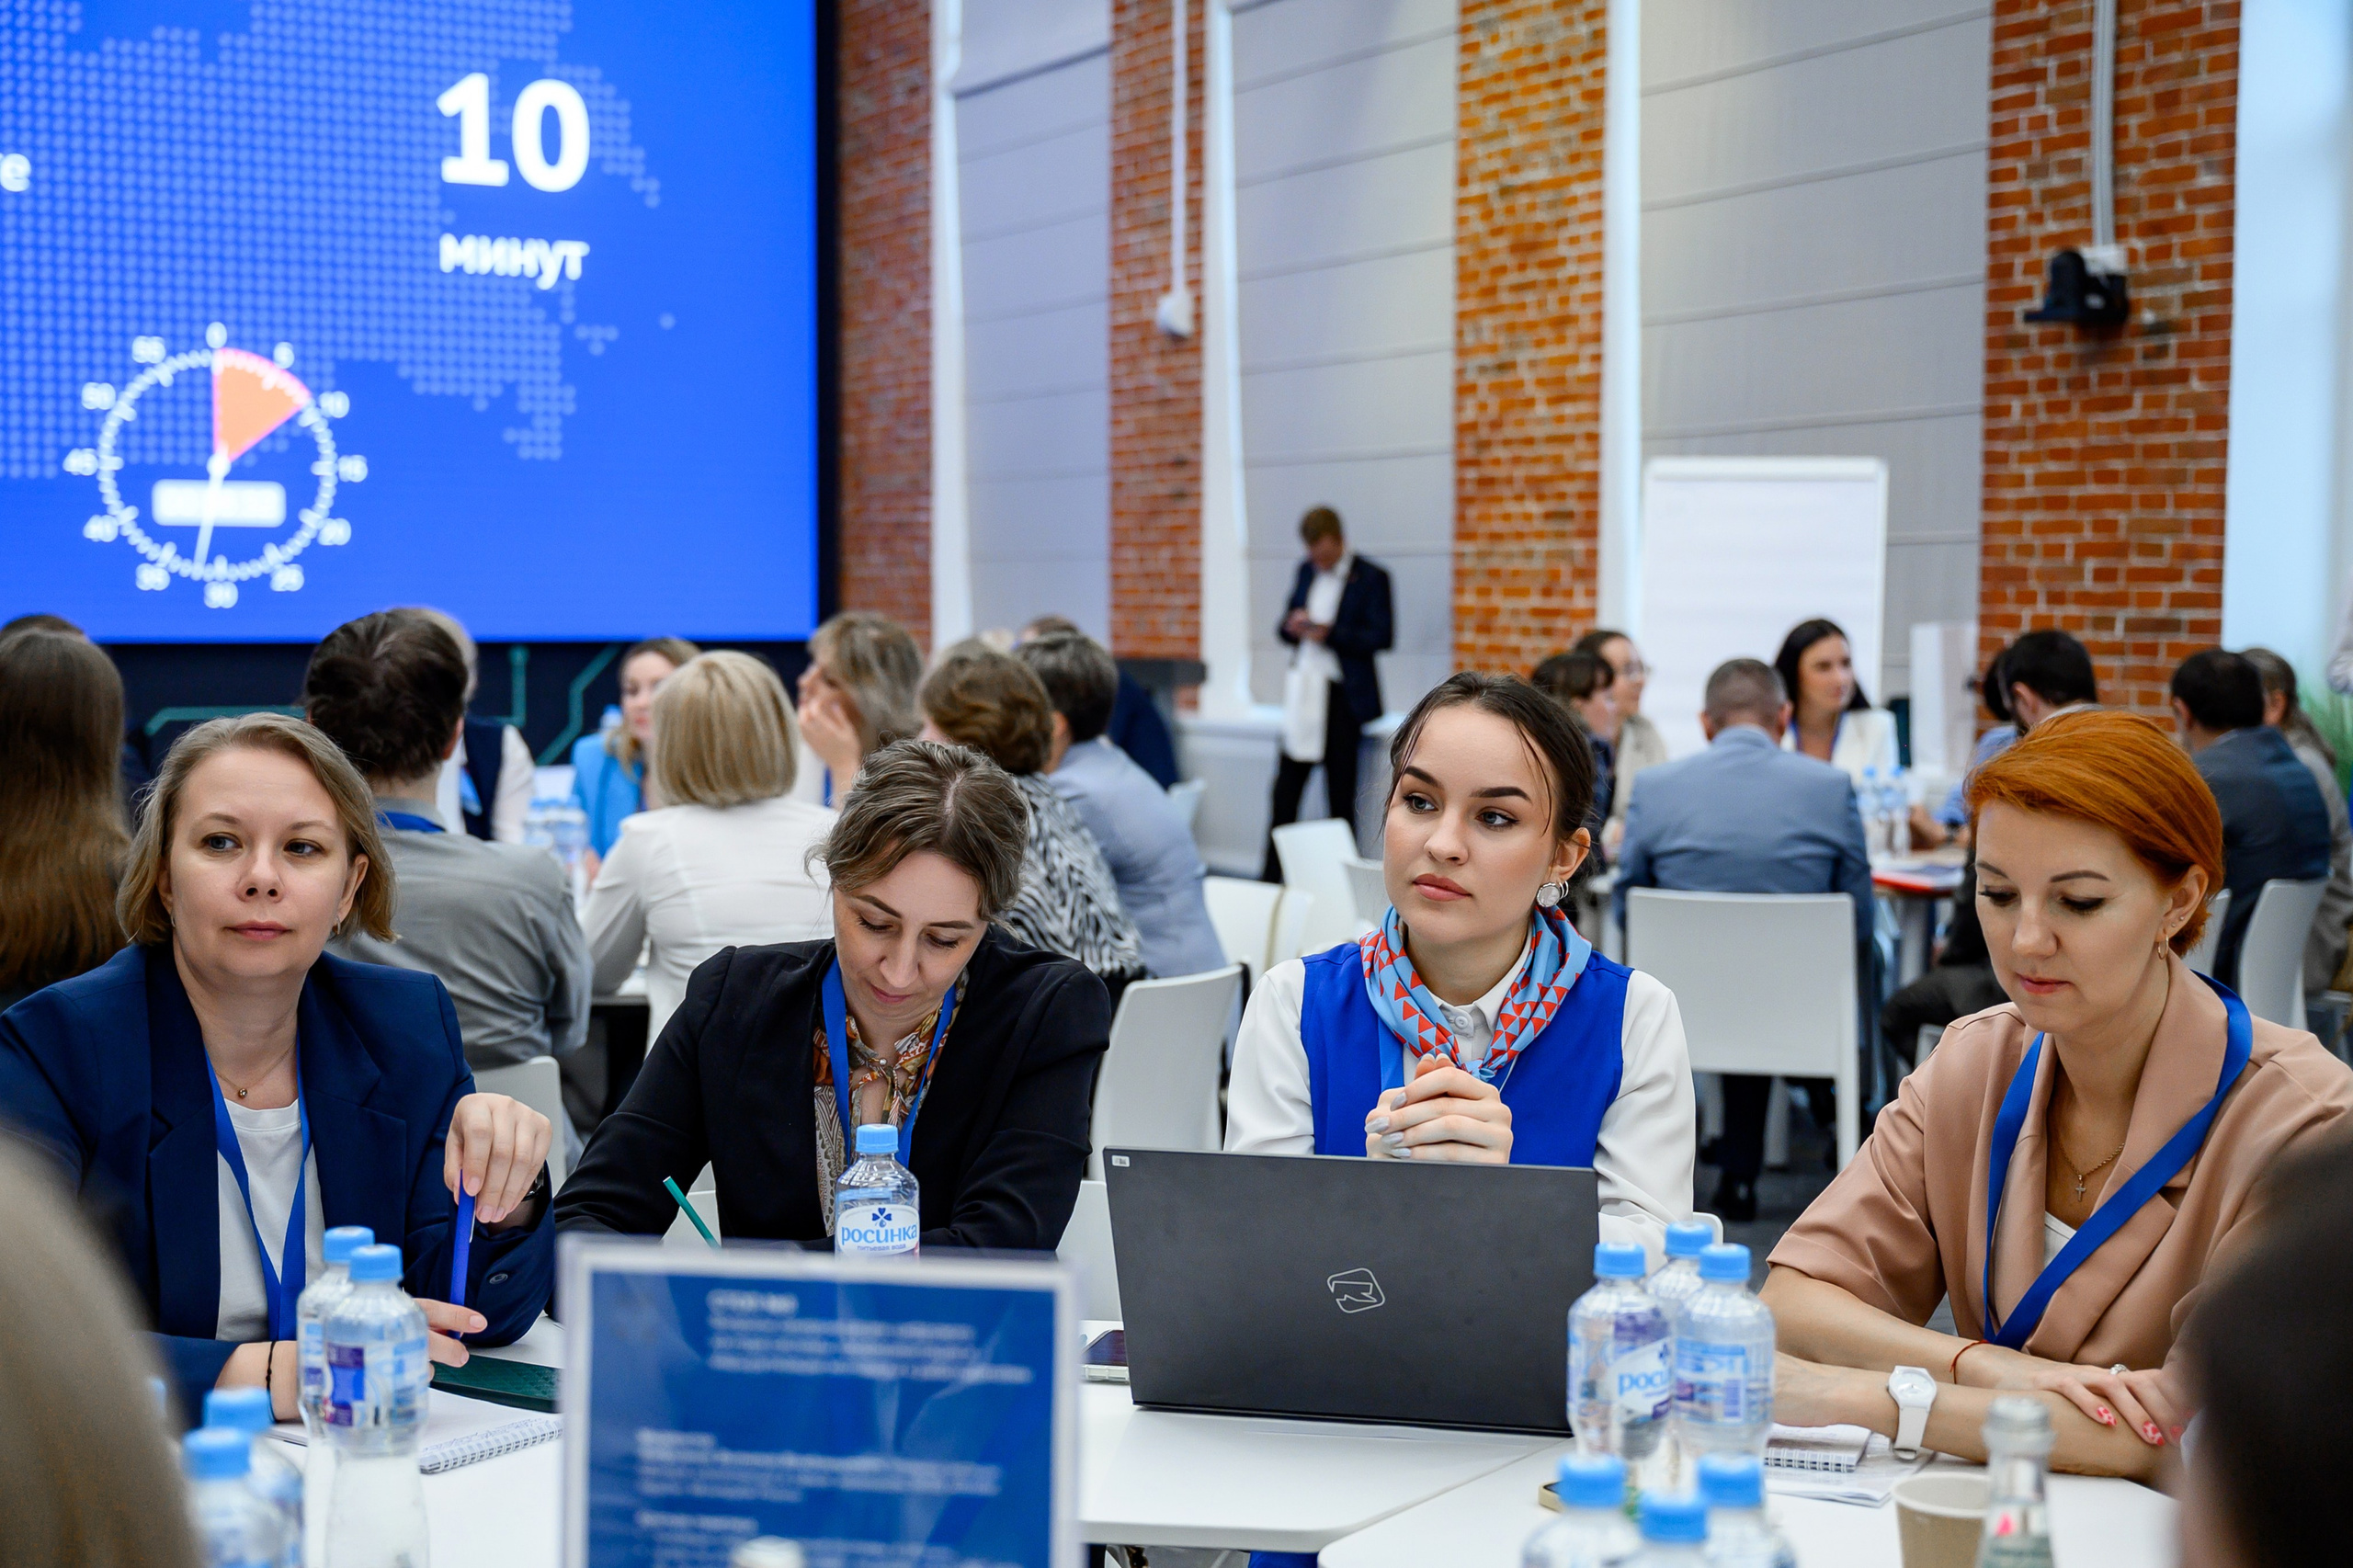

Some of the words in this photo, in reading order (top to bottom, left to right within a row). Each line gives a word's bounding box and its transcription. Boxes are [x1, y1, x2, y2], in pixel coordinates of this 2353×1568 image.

[436, 72, 590, 193] 10
[0, 153, 31, 192] е
[439, 233, 590, 290] минут
[841, 1223, 917, 1246] росинка
